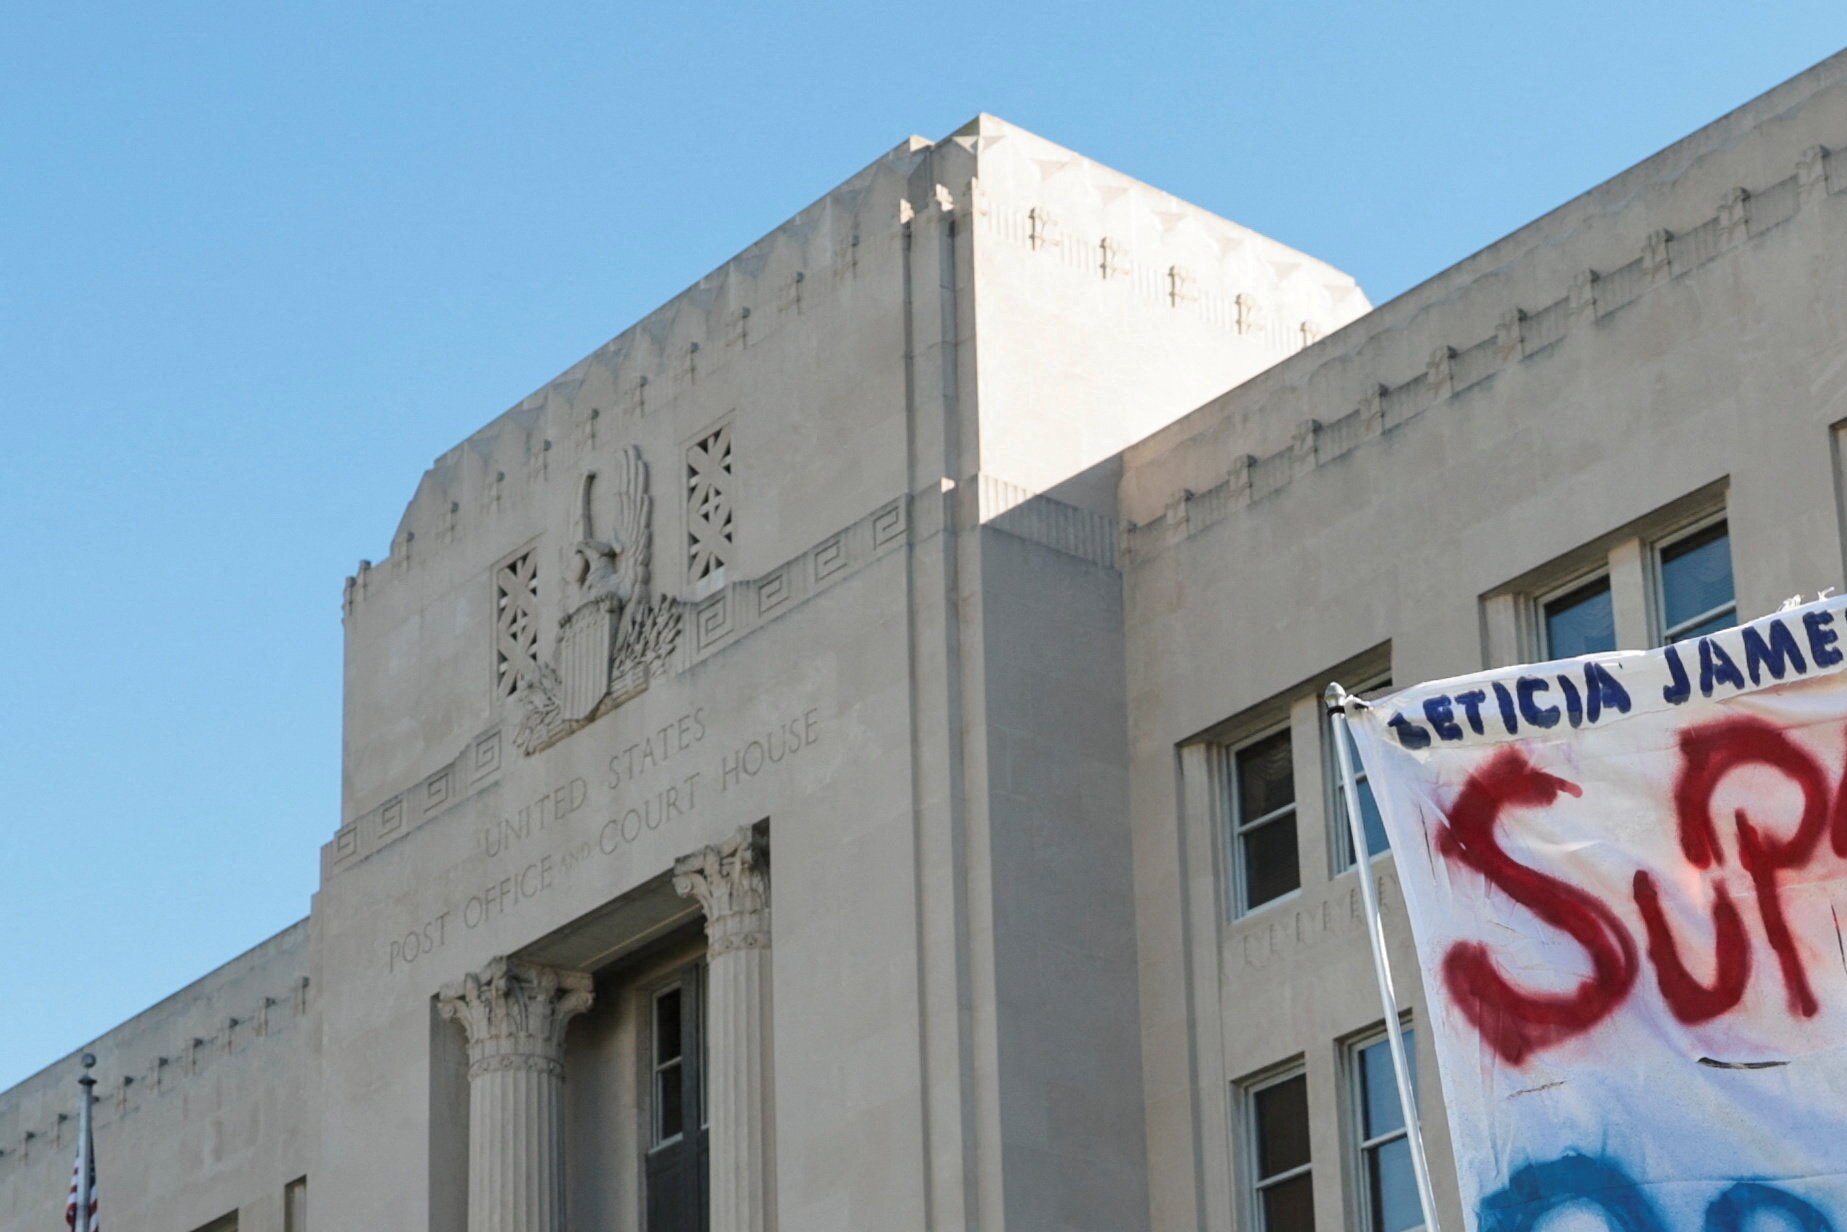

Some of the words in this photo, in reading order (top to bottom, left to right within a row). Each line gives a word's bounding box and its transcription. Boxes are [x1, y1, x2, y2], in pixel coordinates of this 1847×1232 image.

[1388, 661, 1631, 750] LETICIA
[388, 911, 452, 974] POST
[463, 854, 553, 930] OFFICE
[599, 771, 702, 858] COURT
[720, 708, 821, 792] HOUSE
[485, 777, 588, 858] UNITED
[607, 706, 708, 790] STATES
